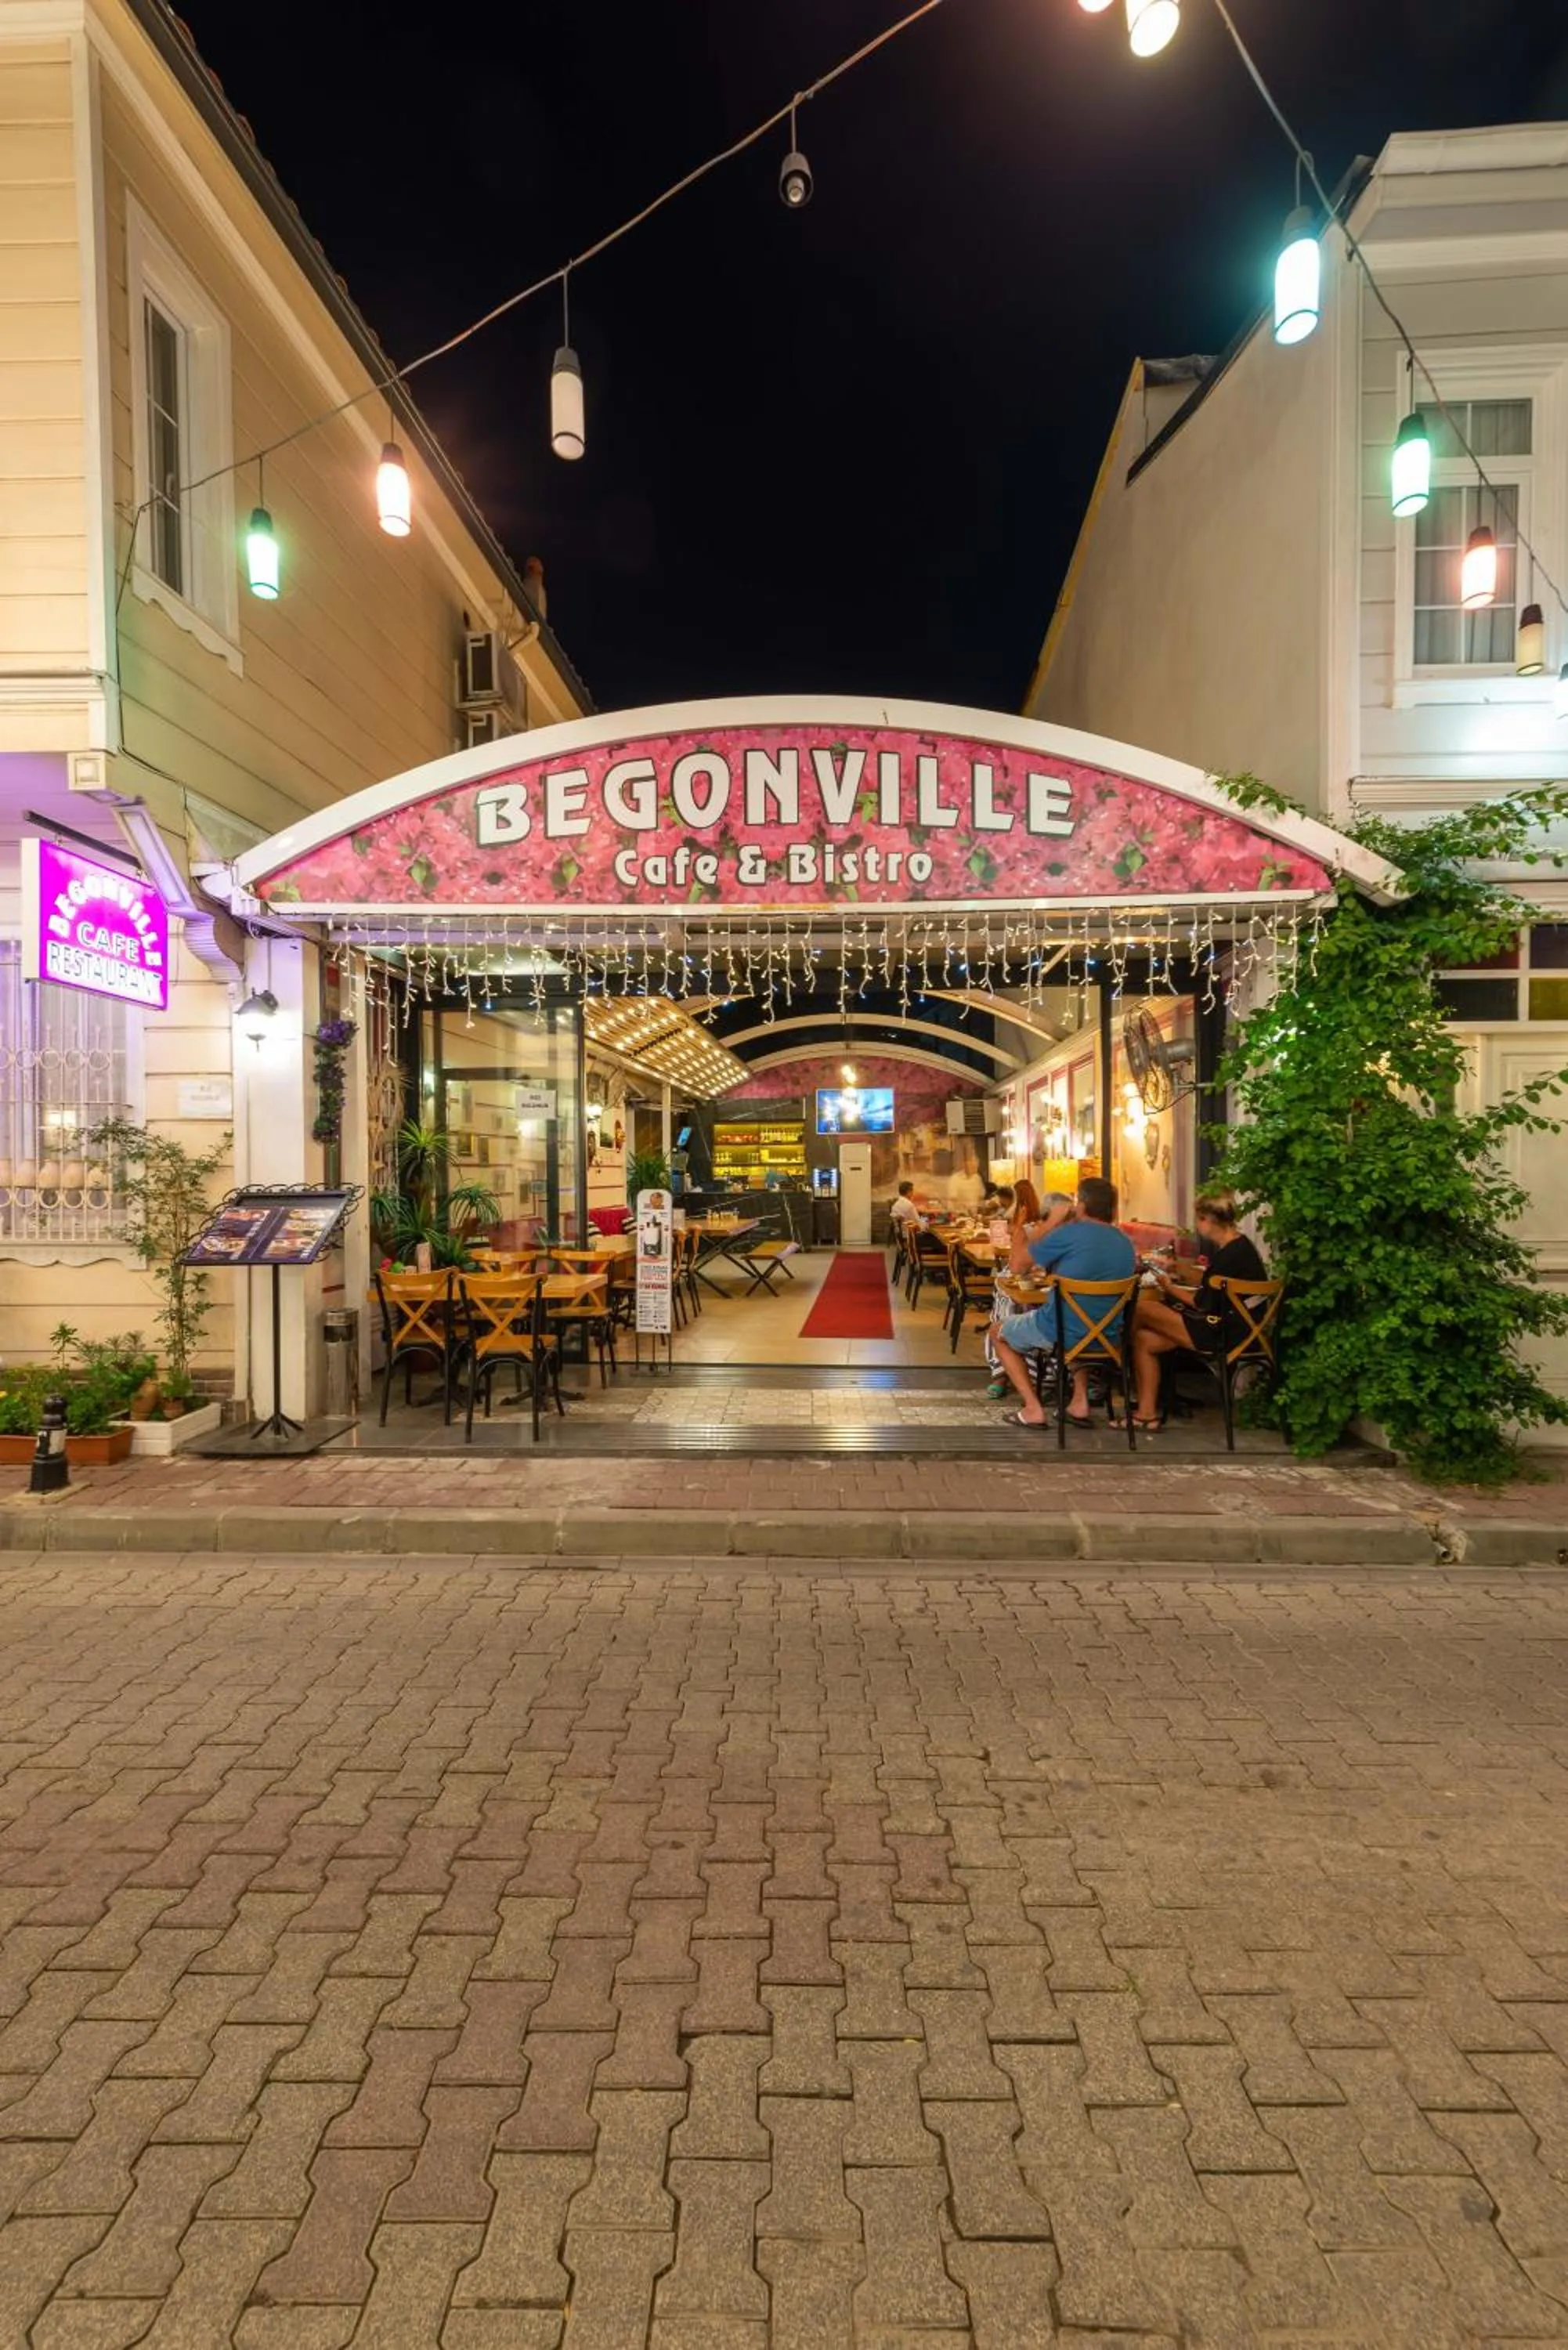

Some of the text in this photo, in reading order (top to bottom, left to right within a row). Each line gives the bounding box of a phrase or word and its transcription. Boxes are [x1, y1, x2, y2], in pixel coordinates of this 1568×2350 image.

[475, 747, 1076, 847] BEGONVILLE
[615, 843, 933, 886] Cafe & Bistro
[78, 922, 139, 962] CAFE
[49, 942, 162, 996] RESTAURANT
